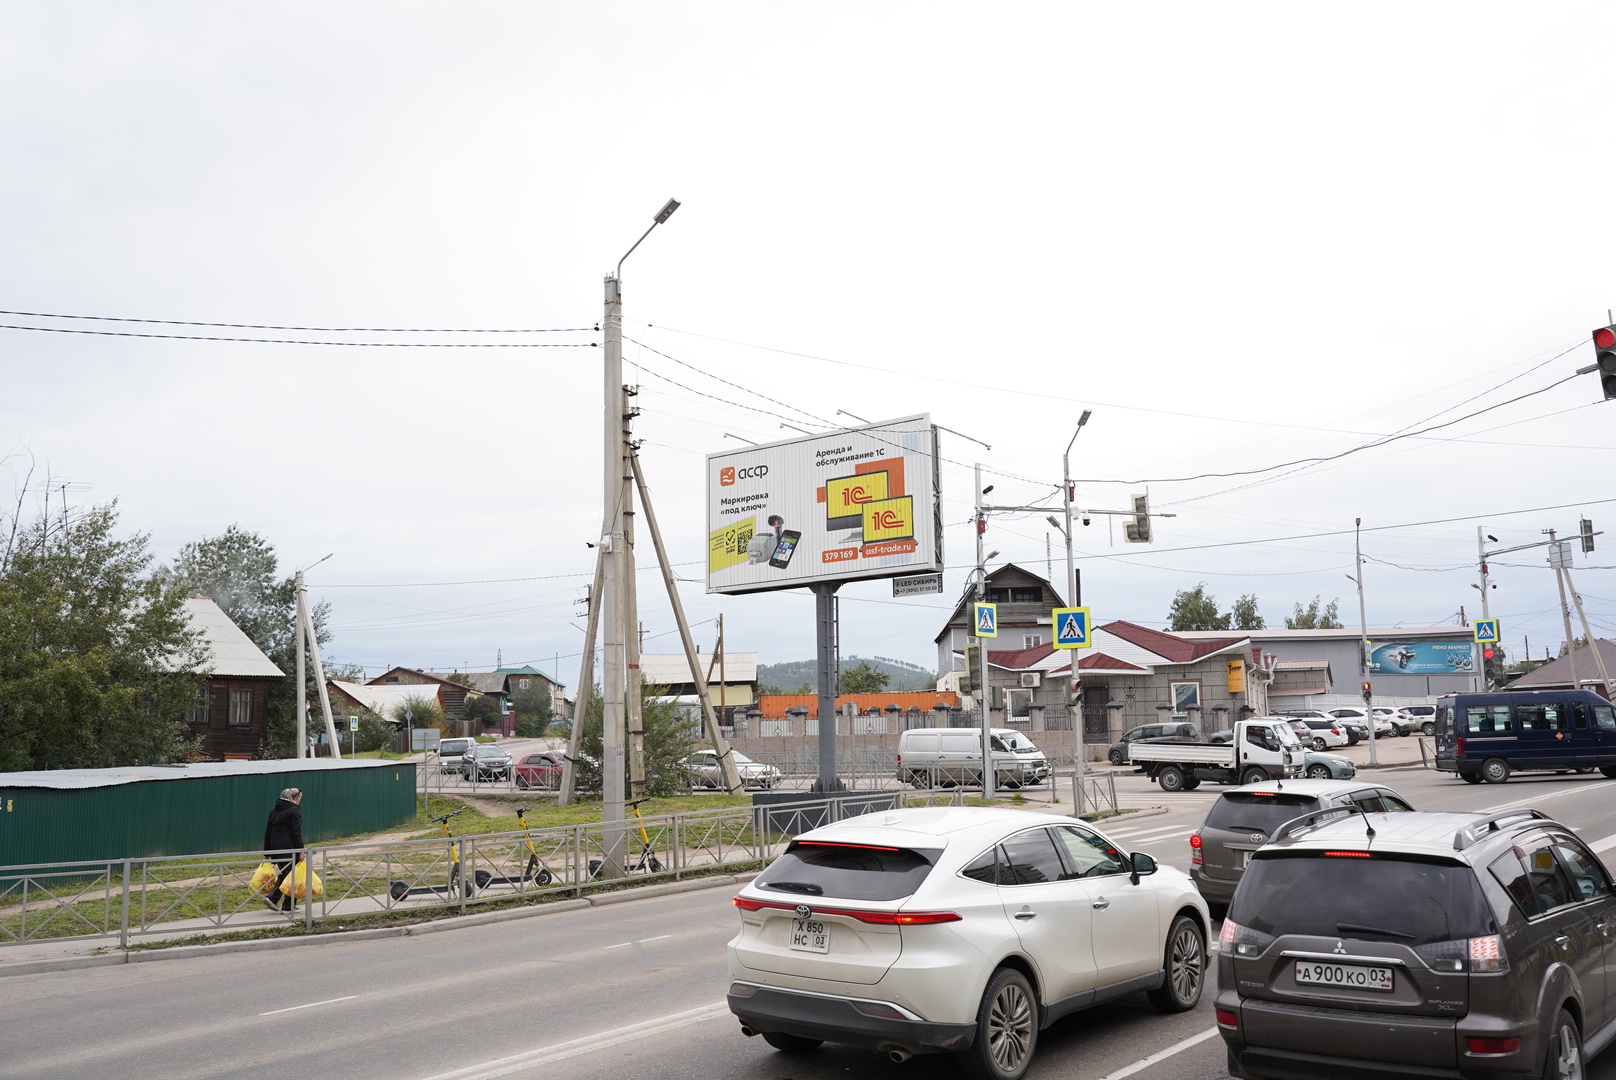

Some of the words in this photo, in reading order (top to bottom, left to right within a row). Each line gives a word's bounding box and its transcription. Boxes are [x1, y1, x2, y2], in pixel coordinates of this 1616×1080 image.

[816, 447, 845, 458] Аренда
[816, 451, 874, 467] обслуживание
[876, 448, 885, 456] 1С
[720, 492, 769, 506] Маркировка
[720, 507, 740, 515] «под
[741, 503, 767, 512] ключ»
[824, 552, 839, 561] 379
[840, 549, 854, 559] 169
[865, 544, 912, 555] asf-trade.ru
[913, 578, 937, 586] СИБИРЬ
[806, 921, 824, 934] 850
[793, 933, 808, 946] НС
[815, 936, 825, 945] 03
[1370, 969, 1386, 982] 03
